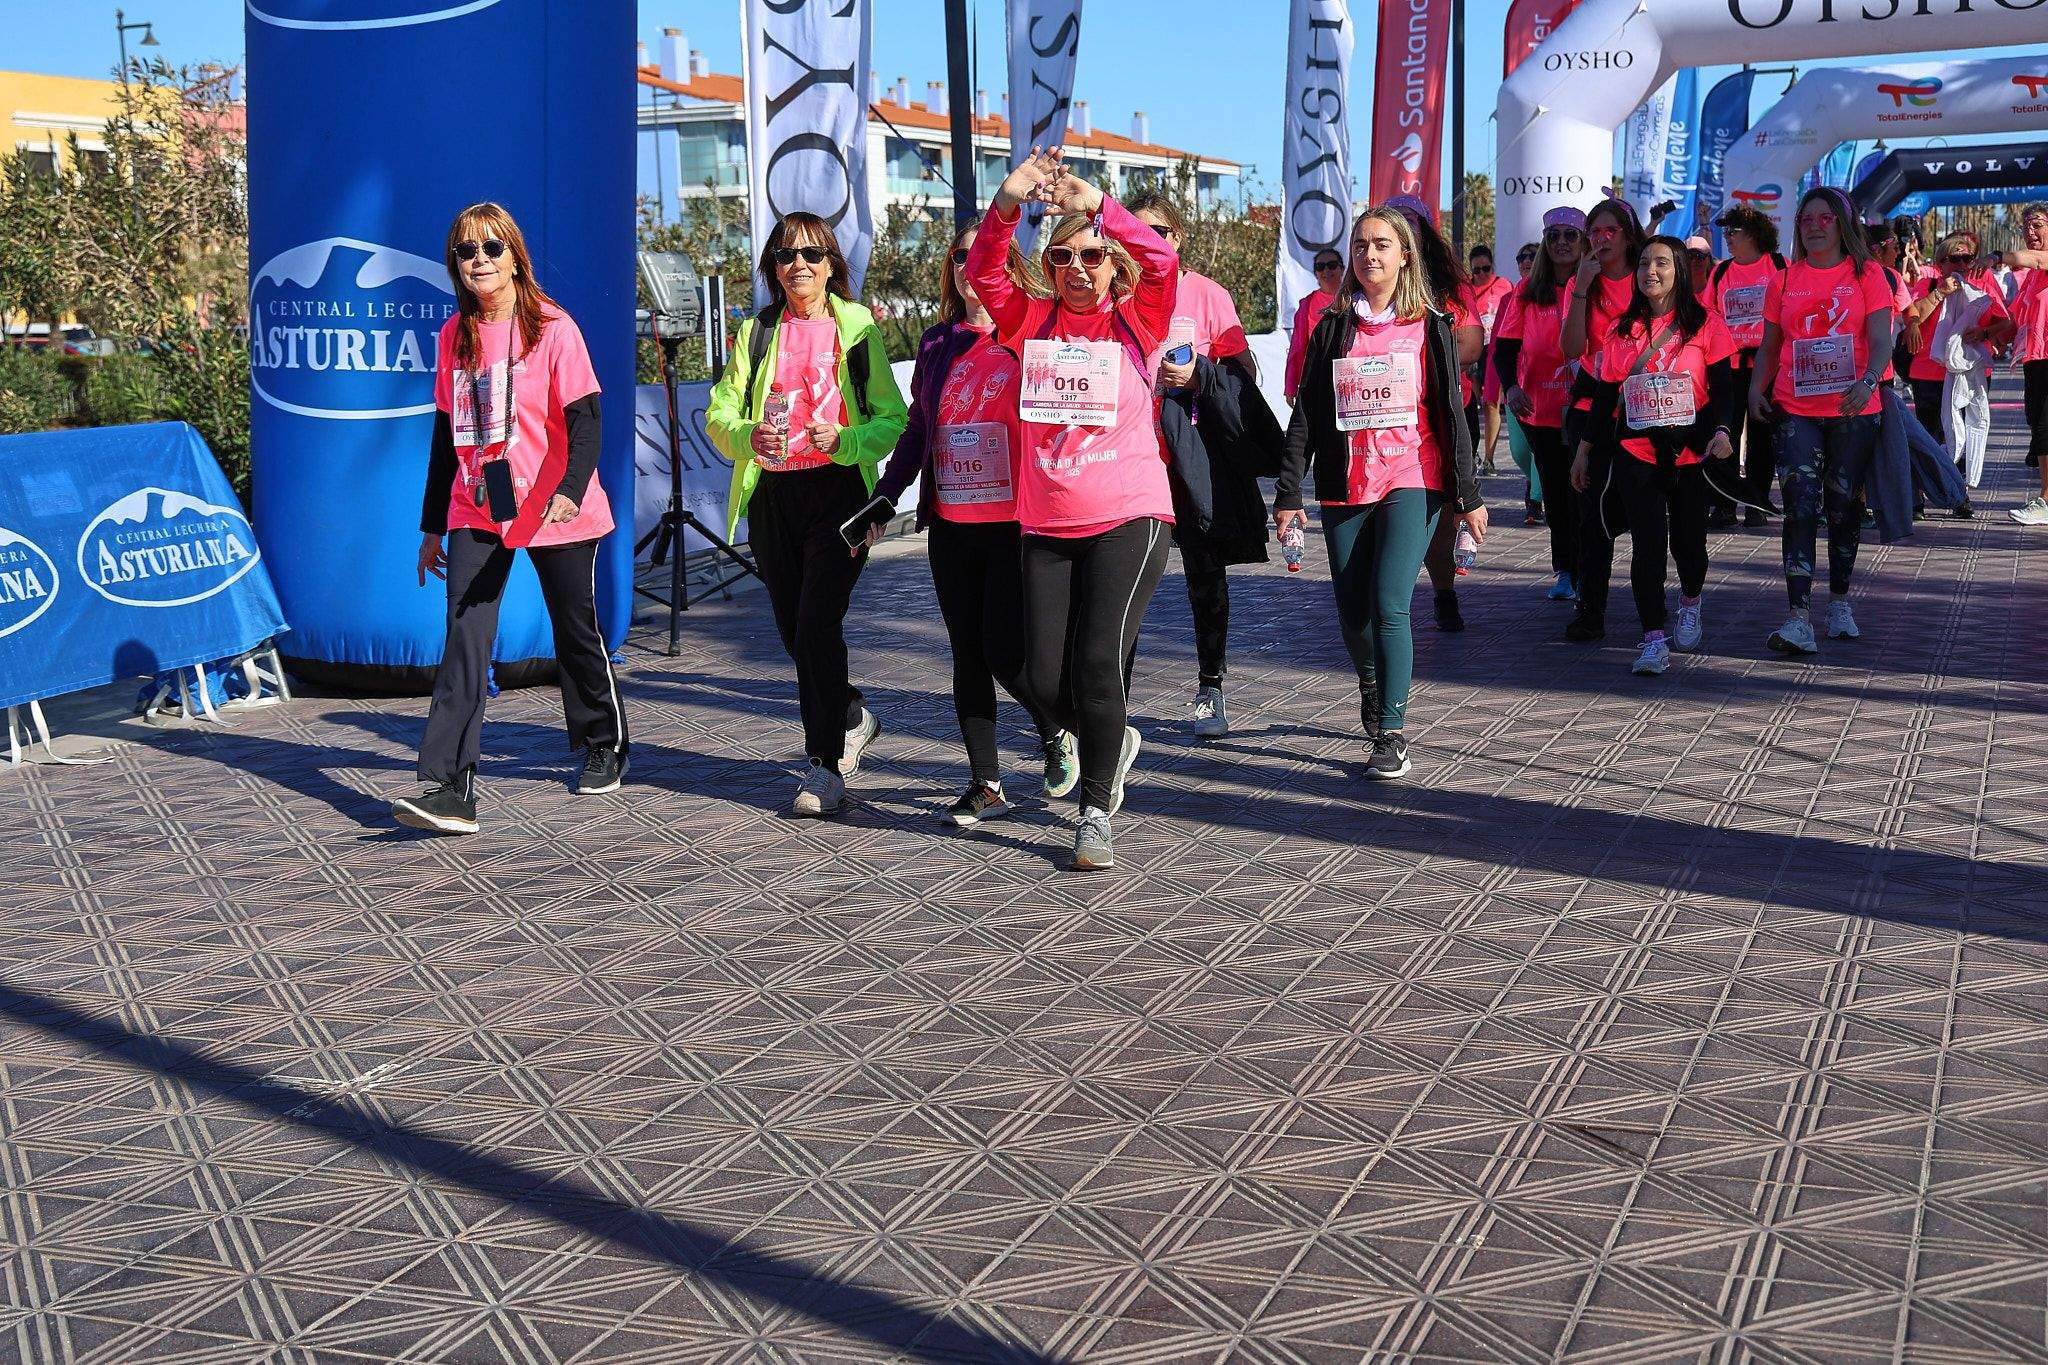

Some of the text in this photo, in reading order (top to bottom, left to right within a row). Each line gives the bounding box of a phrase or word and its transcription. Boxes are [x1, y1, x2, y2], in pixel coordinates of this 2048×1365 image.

[1544, 50, 1634, 72] OYSHO
[1877, 111, 1943, 122] TotalEnergies
[1923, 157, 2048, 175] VOLV
[1504, 175, 1584, 196] OYSHO
[270, 300, 454, 319] CENTRAL LECHE
[1738, 301, 1755, 310] 016
[1814, 361, 1838, 373] 016
[1054, 377, 1090, 391] 016
[1361, 387, 1391, 401] 016
[1649, 396, 1674, 409] 016
[1030, 411, 1061, 419] OYSHO
[1075, 454, 1087, 466] LA
[1087, 449, 1118, 464] MUJER
[953, 459, 983, 473] 016
[116, 528, 172, 545] CENTRAL
[99, 533, 252, 586] ASTURIANA
[0, 567, 48, 604] NA
